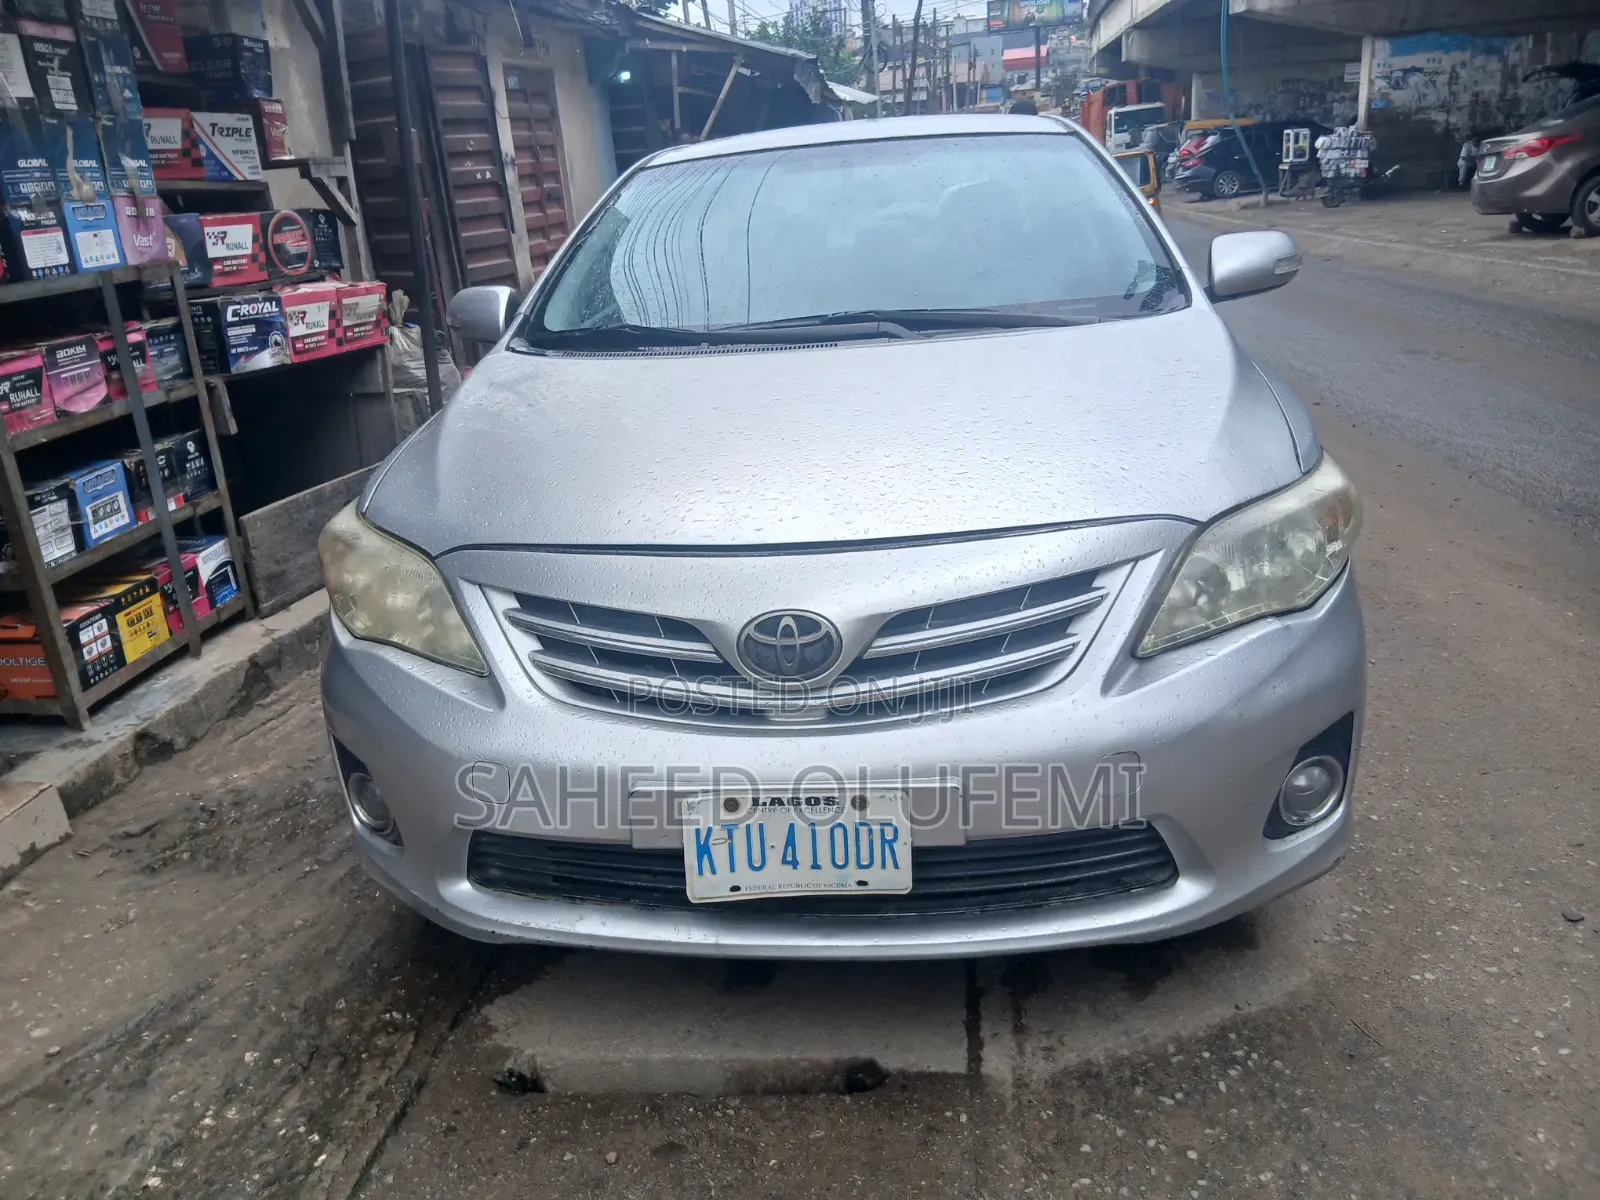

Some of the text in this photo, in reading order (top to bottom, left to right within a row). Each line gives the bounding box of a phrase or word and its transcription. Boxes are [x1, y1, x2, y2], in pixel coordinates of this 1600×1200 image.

[209, 122, 252, 138] TRIPLE
[150, 136, 179, 145] RUNALL
[17, 158, 49, 168] GLOBAL
[132, 234, 154, 246] Vast
[225, 240, 250, 252] RUNALL
[305, 319, 327, 330] RUNALL
[9, 387, 41, 404] RUNALL
[0, 656, 48, 667] OLTIGE
[752, 796, 840, 807] LAGOS
[747, 806, 846, 814] CENTRE OF EXCELLENCE
[744, 884, 777, 892] FEDERAL
[778, 882, 812, 890] REPUBLIC
